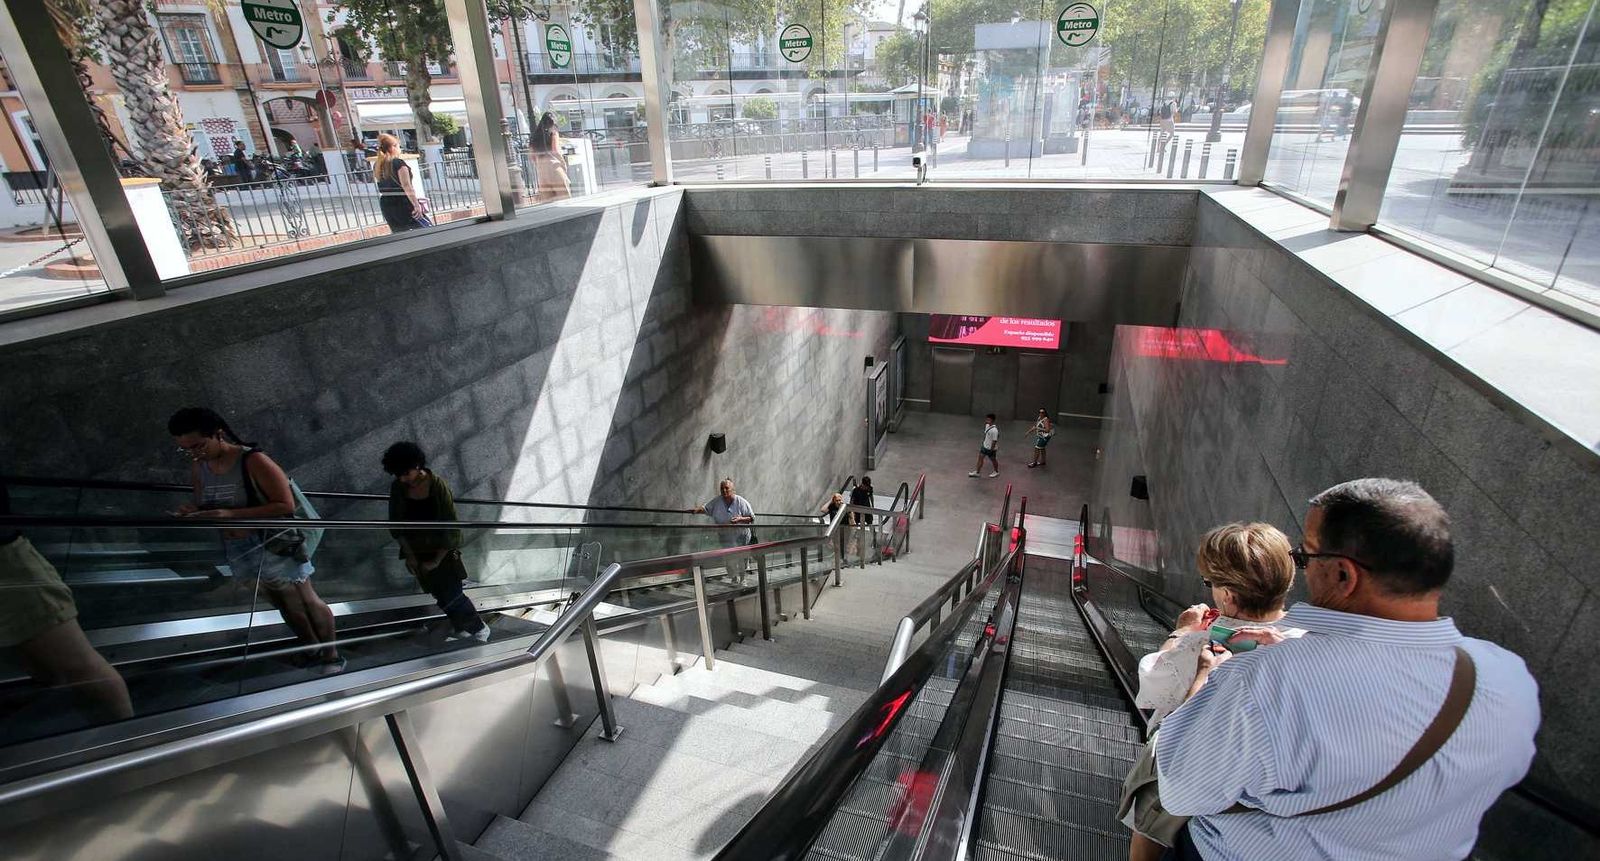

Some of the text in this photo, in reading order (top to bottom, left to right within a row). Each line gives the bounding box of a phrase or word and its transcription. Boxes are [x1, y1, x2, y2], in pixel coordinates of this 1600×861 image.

[253, 7, 293, 23] Metro
[1064, 21, 1093, 30] Metro
[550, 41, 568, 51] Metro
[784, 40, 807, 48] Metro
[1009, 317, 1020, 325] los
[1020, 319, 1056, 327] resultados
